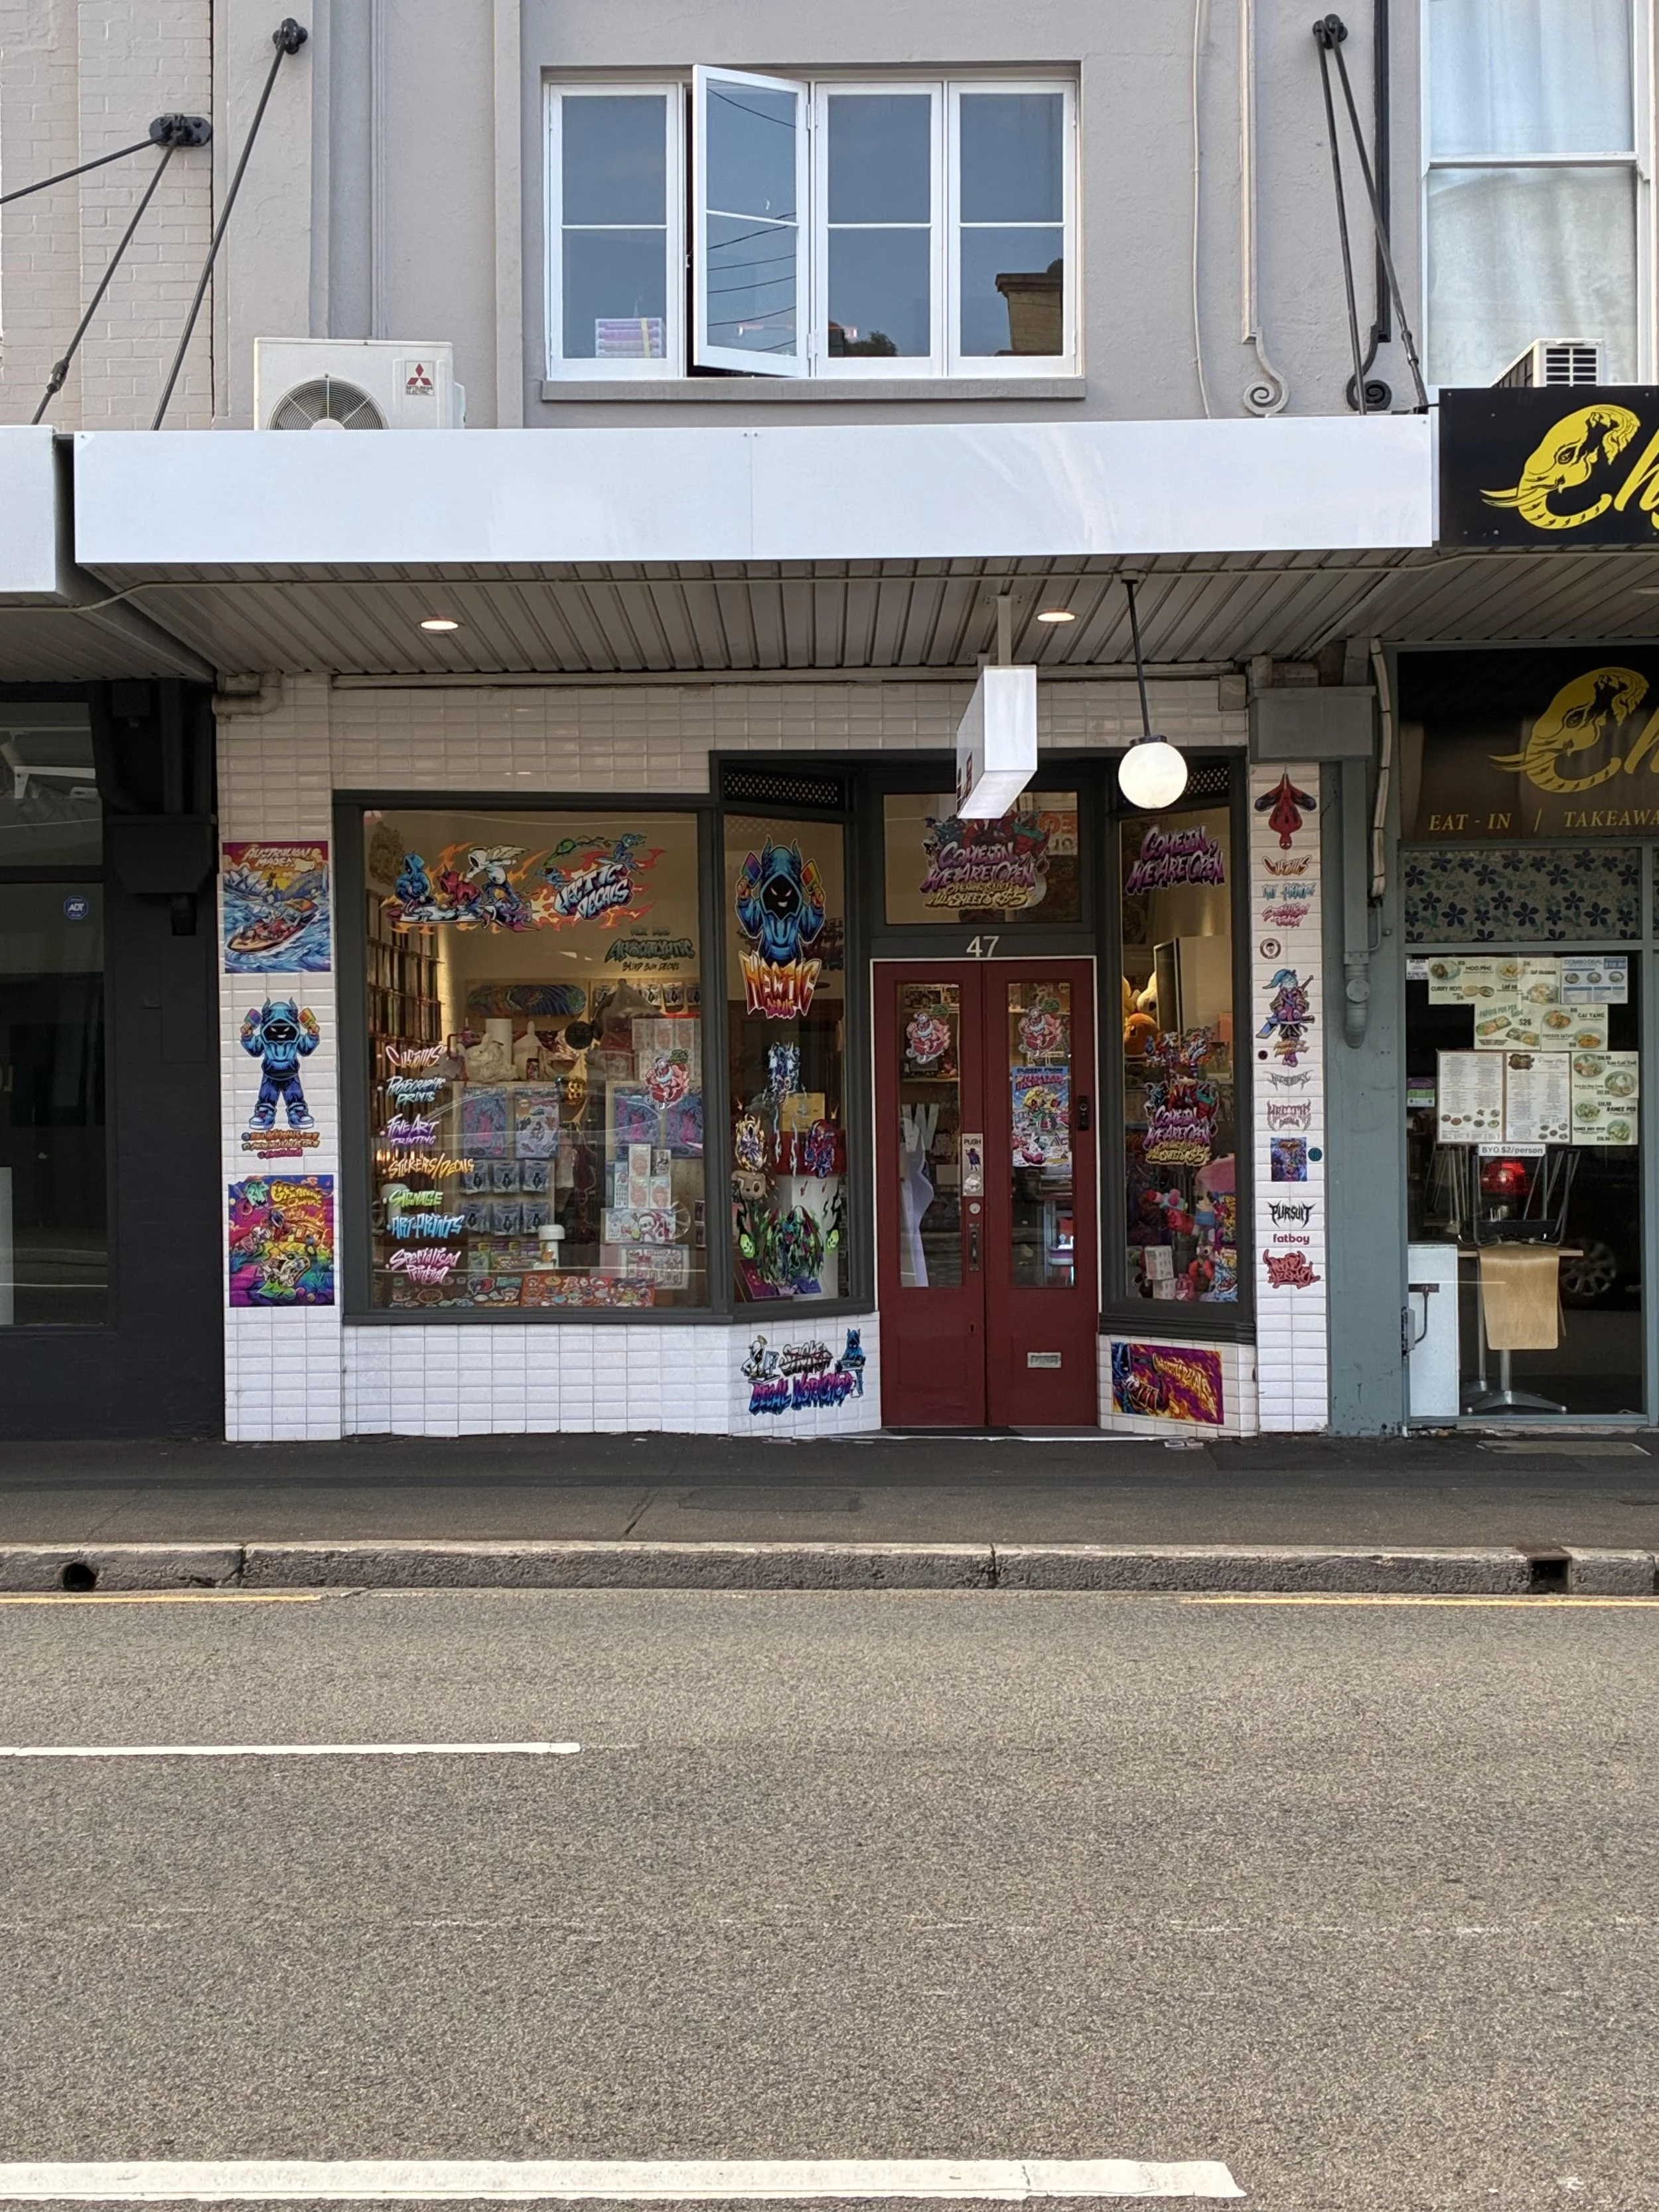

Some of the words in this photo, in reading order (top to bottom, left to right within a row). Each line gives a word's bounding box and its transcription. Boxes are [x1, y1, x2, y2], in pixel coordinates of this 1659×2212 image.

[1428, 814, 1468, 832] EAT
[555, 864, 624, 916] HECTIC
[577, 878, 630, 919] DECALS
[68, 903, 84, 912] ADT
[966, 935, 999, 958] 47
[739, 950, 822, 1017] HECTIC
[410, 1114, 440, 1136] ART
[389, 1189, 444, 1208] SIGNAGE
[1273, 1234, 1310, 1245] fatboy
